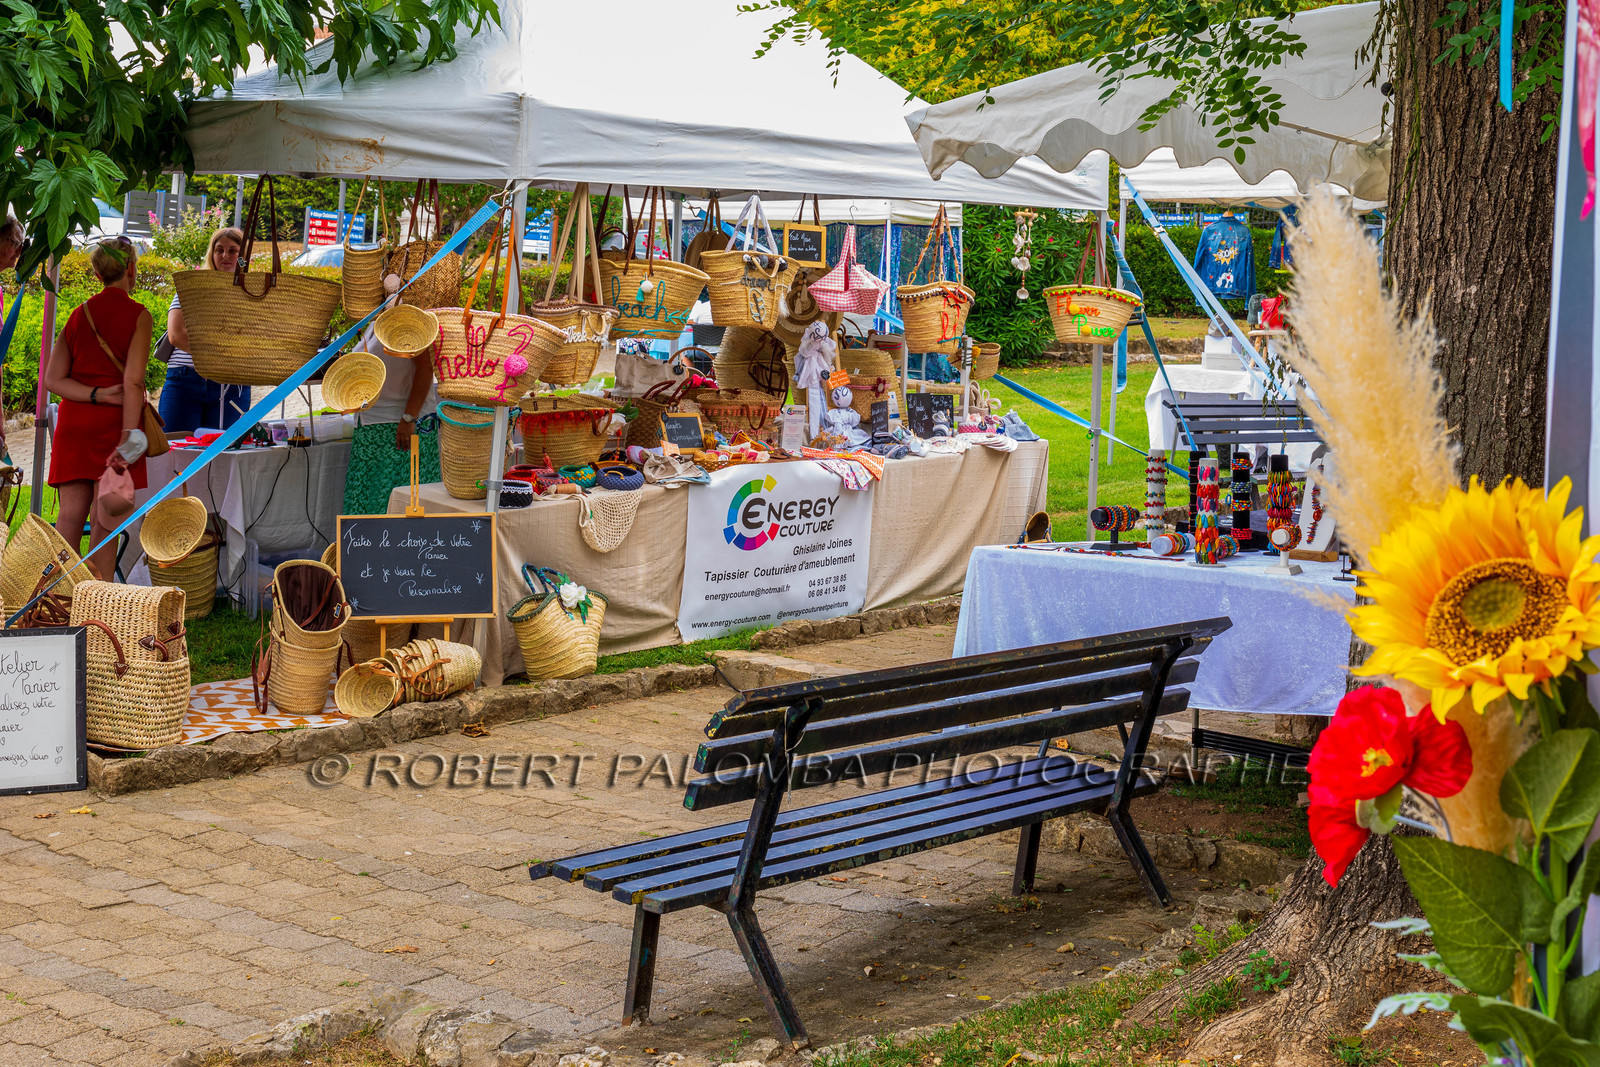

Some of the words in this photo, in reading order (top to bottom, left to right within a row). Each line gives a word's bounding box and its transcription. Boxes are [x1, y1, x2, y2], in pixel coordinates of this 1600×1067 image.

[611, 275, 670, 322] beach
[432, 324, 500, 382] hello
[742, 495, 840, 530] ENERGY
[343, 523, 372, 555] Faites
[379, 529, 391, 548] le
[397, 531, 427, 551] choix
[779, 519, 835, 538] COUTURE
[793, 542, 826, 556] Ghislaine
[827, 538, 853, 550] Joines
[360, 562, 374, 578] et
[382, 564, 391, 583] je
[704, 569, 749, 583] Tapissier
[753, 563, 797, 578] Couturière
[798, 553, 855, 571] d'ameublement
[705, 584, 791, 601] energycouture@hotmail.fr
[808, 579, 816, 588] 04
[817, 577, 824, 586] 93
[825, 576, 832, 585] 67
[833, 575, 840, 584] 38
[840, 573, 847, 582] 85
[808, 590, 815, 598] 06
[816, 588, 823, 597] 08
[824, 587, 831, 595] 41
[832, 586, 839, 594] 34
[839, 585, 846, 593] 09
[691, 613, 771, 629] www.energy-couture.com
[776, 600, 849, 620] @energycoutureetpeinture
[0, 650, 45, 675] telier
[12, 672, 61, 696] Panier
[0, 693, 30, 716] alisez
